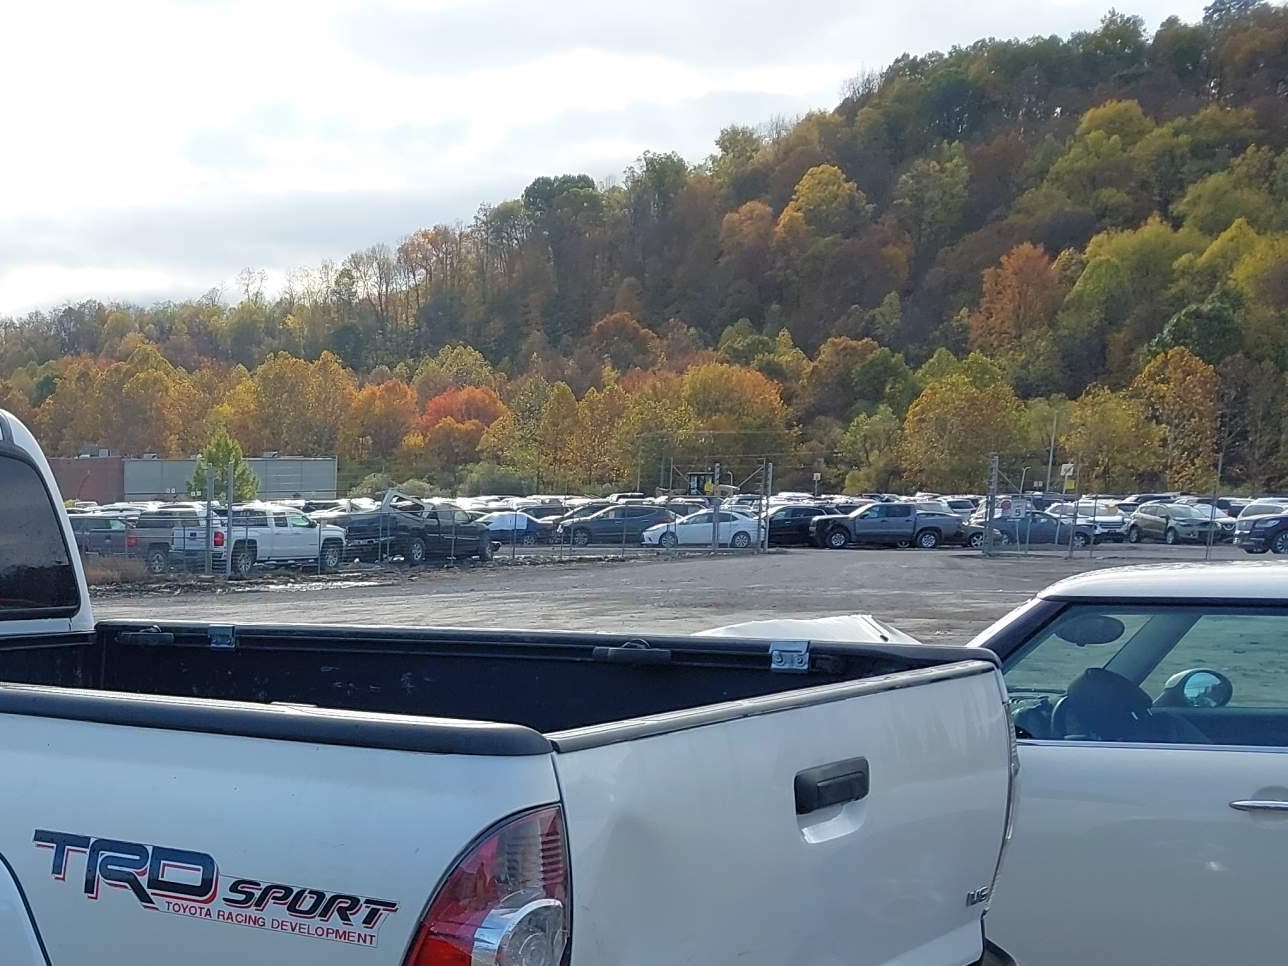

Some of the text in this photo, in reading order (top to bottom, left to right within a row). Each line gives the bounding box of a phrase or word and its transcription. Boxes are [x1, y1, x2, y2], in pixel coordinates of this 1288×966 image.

[32, 829, 399, 930] TRD SPORT
[165, 900, 376, 946] TOYOTA RACING DEVELOPMENT
